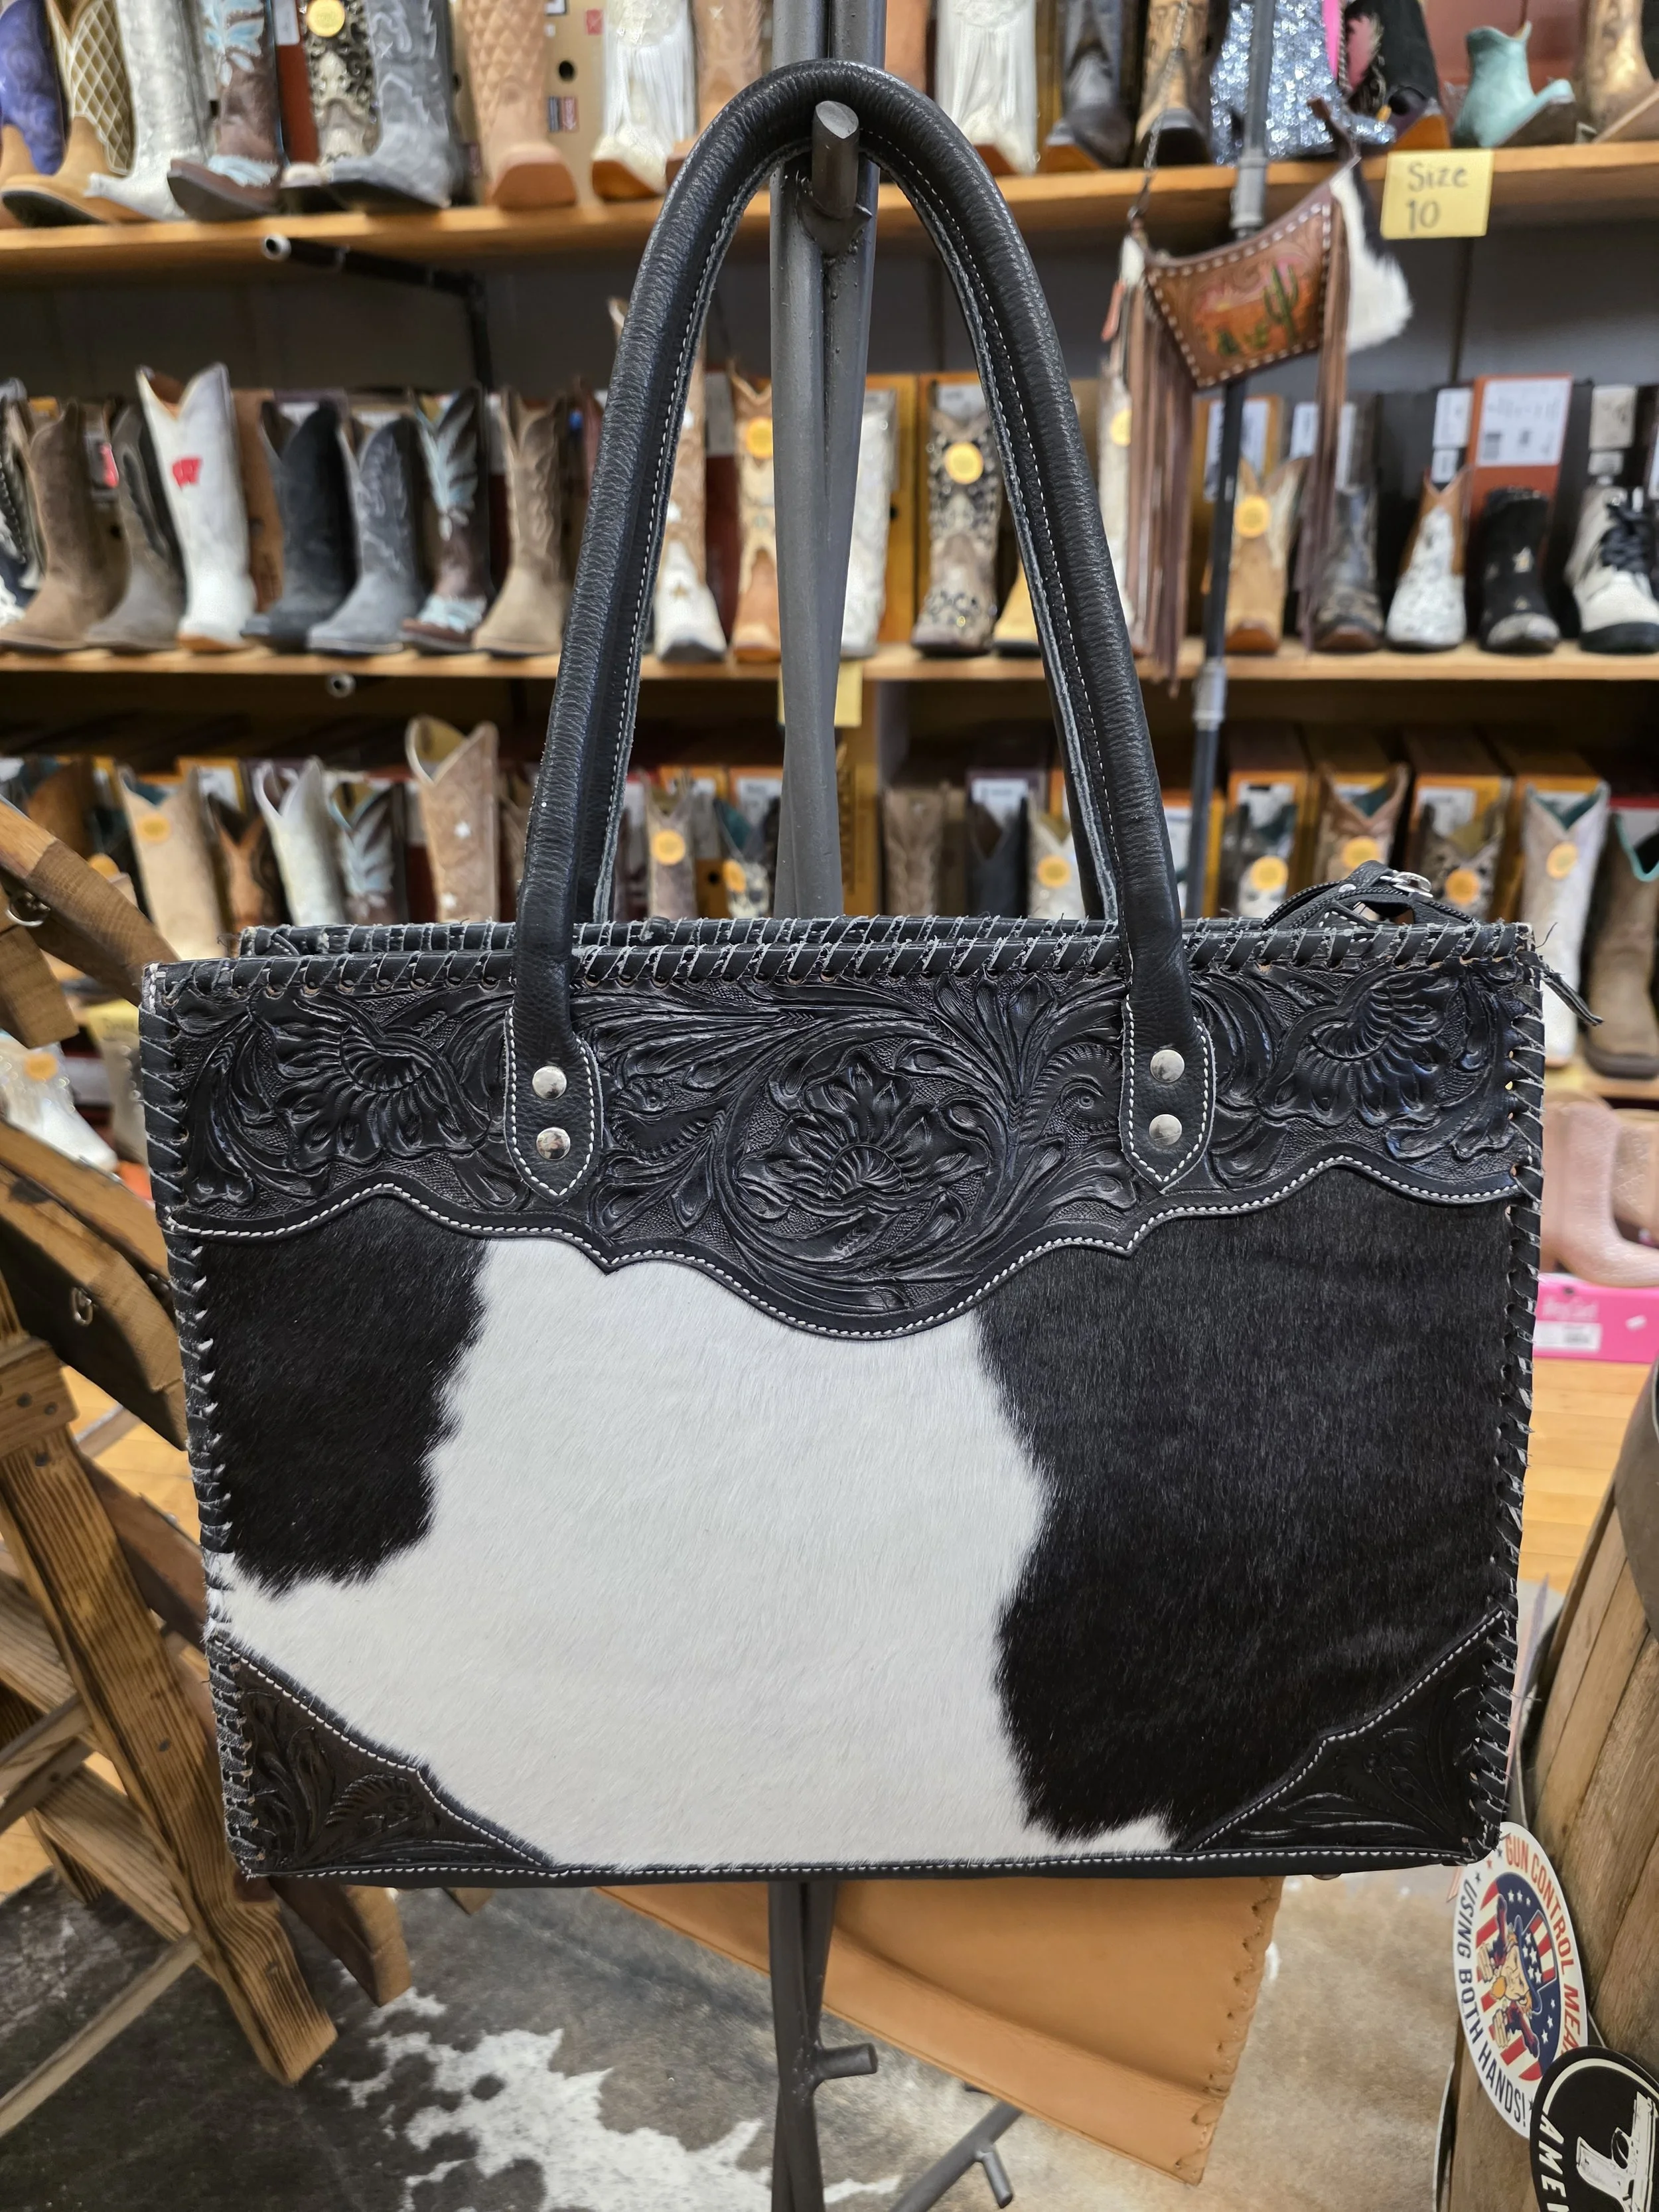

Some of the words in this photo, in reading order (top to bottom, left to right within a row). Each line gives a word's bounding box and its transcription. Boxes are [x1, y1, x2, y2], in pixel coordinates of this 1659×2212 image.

[1407, 161, 1469, 192] Size
[1405, 198, 1441, 233] 10
[1457, 1879, 1478, 1958] USING
[1505, 1835, 1529, 1874] GUN
[1531, 1853, 1574, 1974] CONTROL
[1561, 1983, 1581, 2055] MEA
[1459, 1968, 1484, 2044] BOTH
[1478, 2041, 1526, 2127] HANDS!
